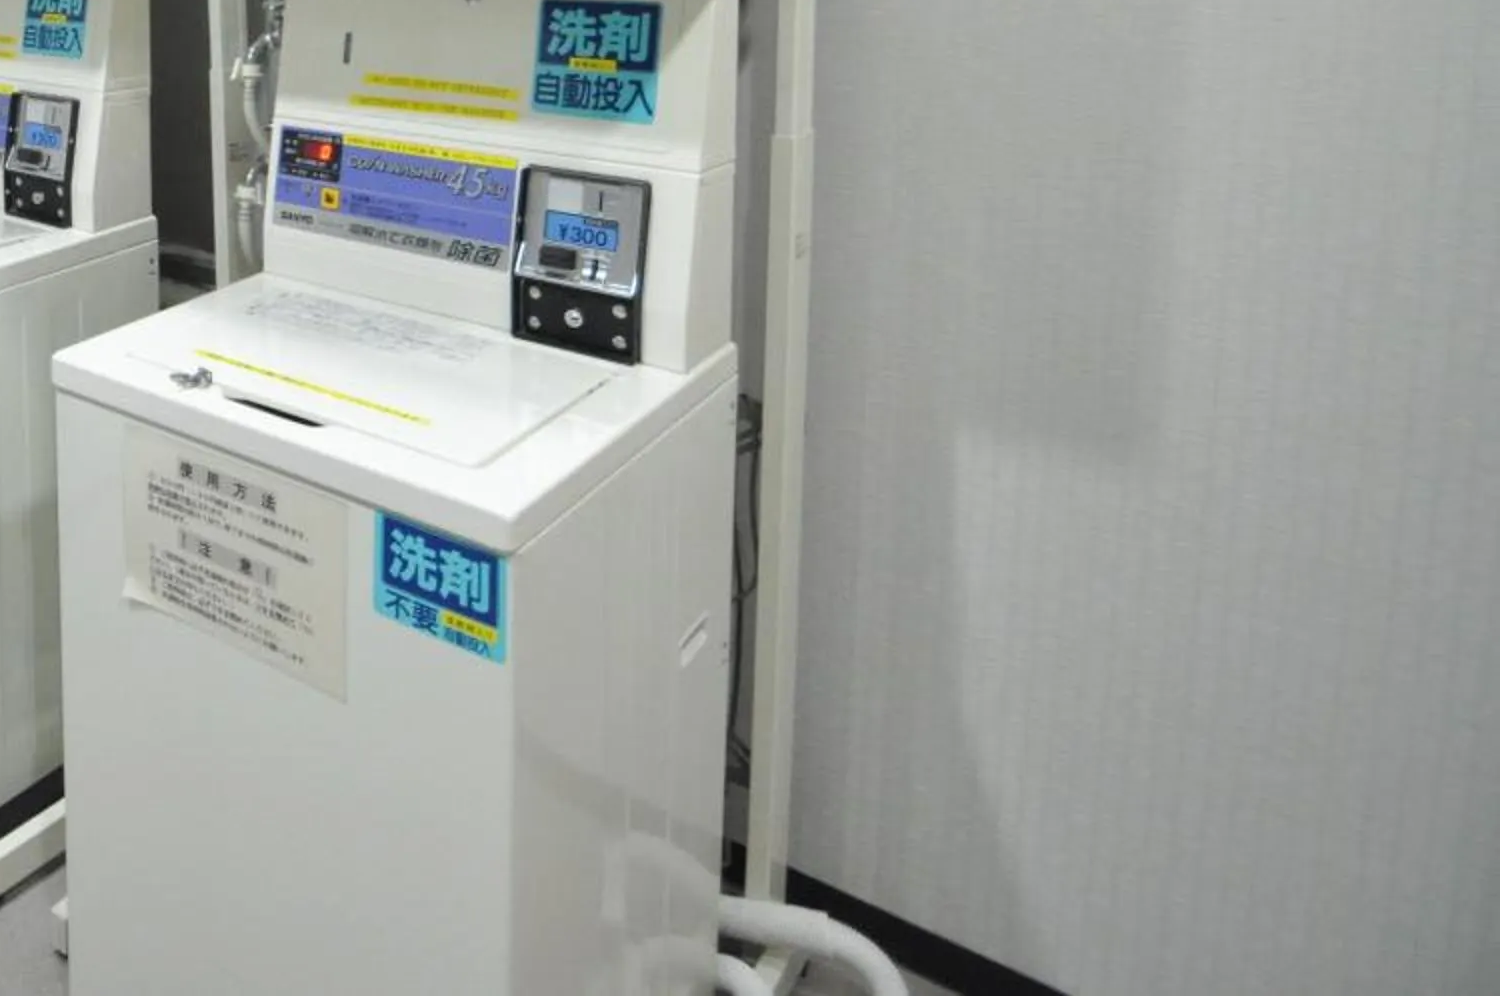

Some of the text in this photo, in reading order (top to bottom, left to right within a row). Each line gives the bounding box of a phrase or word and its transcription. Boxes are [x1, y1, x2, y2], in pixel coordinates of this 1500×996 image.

[547, 8, 653, 64] 洗剤
[535, 72, 655, 118] 自動投入
[448, 163, 489, 200] 45
[558, 223, 608, 247] ¥300
[388, 527, 492, 614] 洗剤
[384, 588, 438, 636] 不要
